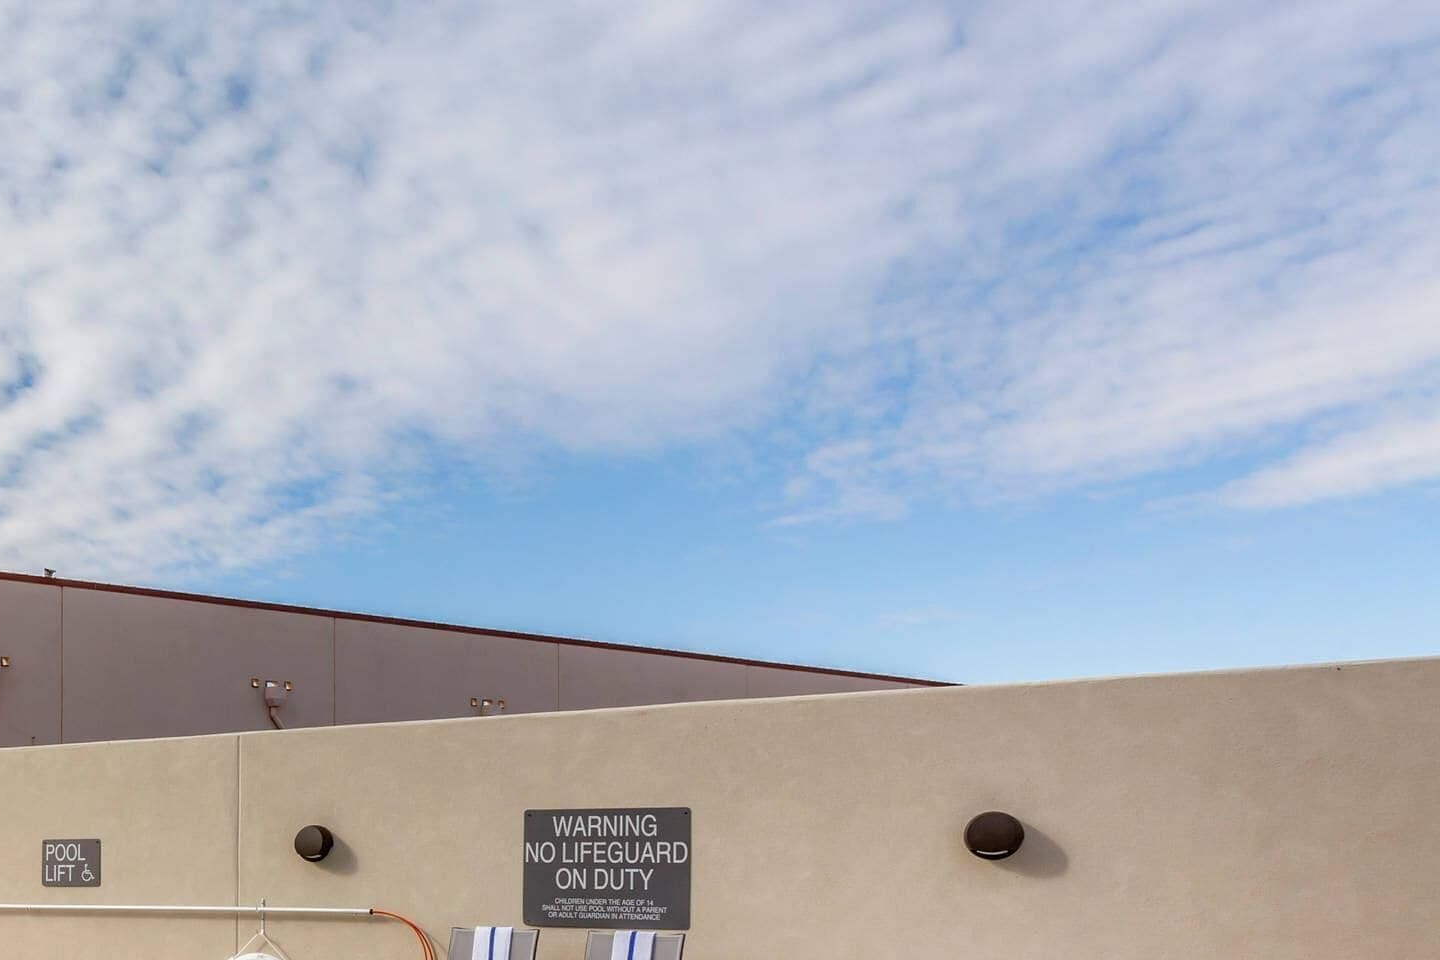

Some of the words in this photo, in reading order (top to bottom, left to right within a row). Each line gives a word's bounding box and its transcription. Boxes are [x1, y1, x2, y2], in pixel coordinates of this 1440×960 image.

[553, 814, 658, 837] WARNING
[46, 843, 86, 861] POOL
[525, 841, 556, 864] NO
[562, 841, 689, 864] LIFEGUARD
[45, 864, 76, 882] LIFT
[555, 867, 587, 890] ON
[594, 868, 654, 891] DUTY
[554, 897, 585, 905] CHILDREN
[608, 898, 620, 906] THE
[562, 904, 575, 912] NOT
[589, 905, 606, 913] POOL
[607, 905, 635, 913] WITHOUT
[642, 906, 667, 914] PARENT
[559, 911, 577, 919] ADULT
[578, 911, 610, 920] GUARDIAN
[619, 912, 661, 921] ATTENDANCE
